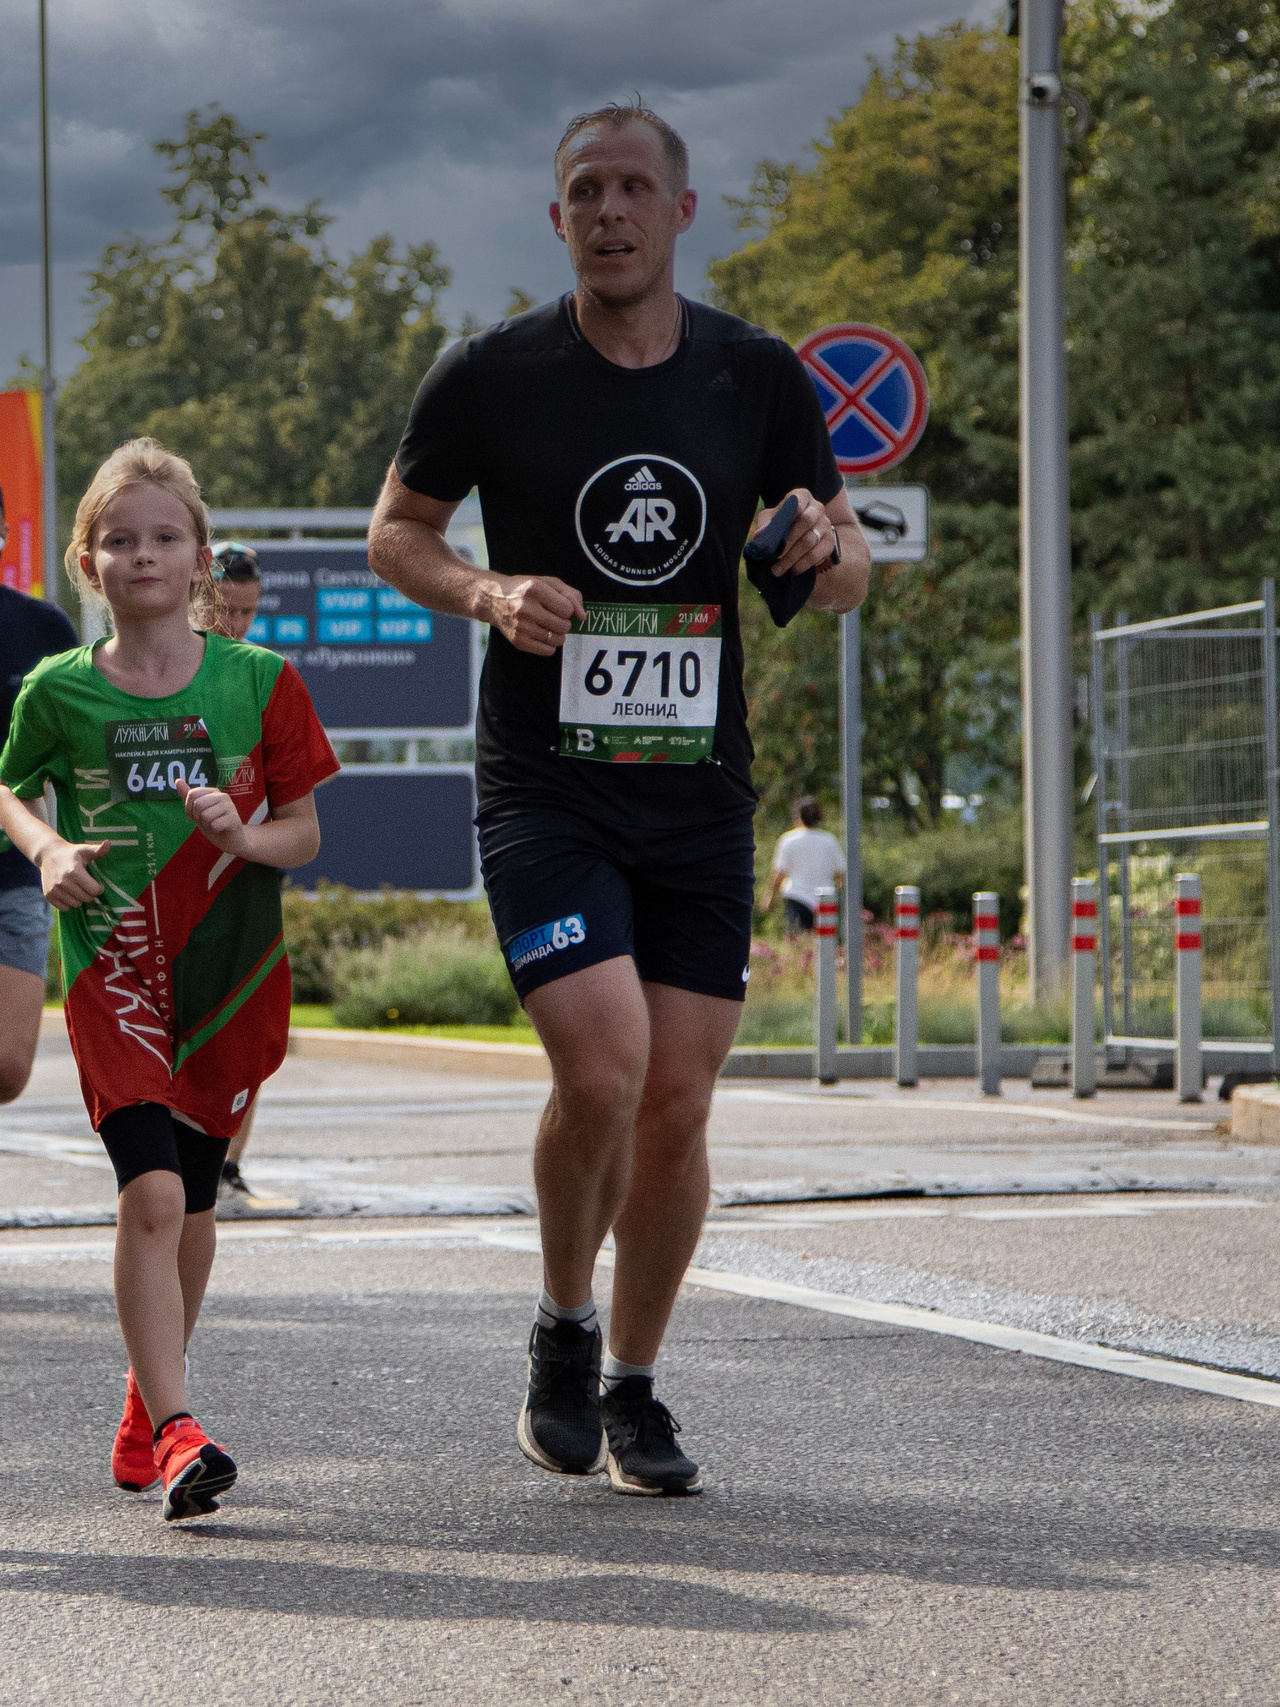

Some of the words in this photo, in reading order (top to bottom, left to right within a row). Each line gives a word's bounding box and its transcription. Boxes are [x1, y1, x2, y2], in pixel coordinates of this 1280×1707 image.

[624, 481, 662, 491] adidas
[605, 498, 677, 543] AR
[594, 542, 618, 567] ADIDAS
[620, 564, 657, 575] RUNNERS
[663, 538, 689, 569] MOSCOW
[579, 609, 658, 634] ЛУЖНИКИ
[584, 649, 701, 698] 6710
[612, 701, 678, 719] ЛЕОНИД
[114, 725, 169, 743] ЛУЖНИКИ
[576, 727, 596, 752] B
[127, 759, 208, 793] 6404
[552, 917, 586, 950] 63
